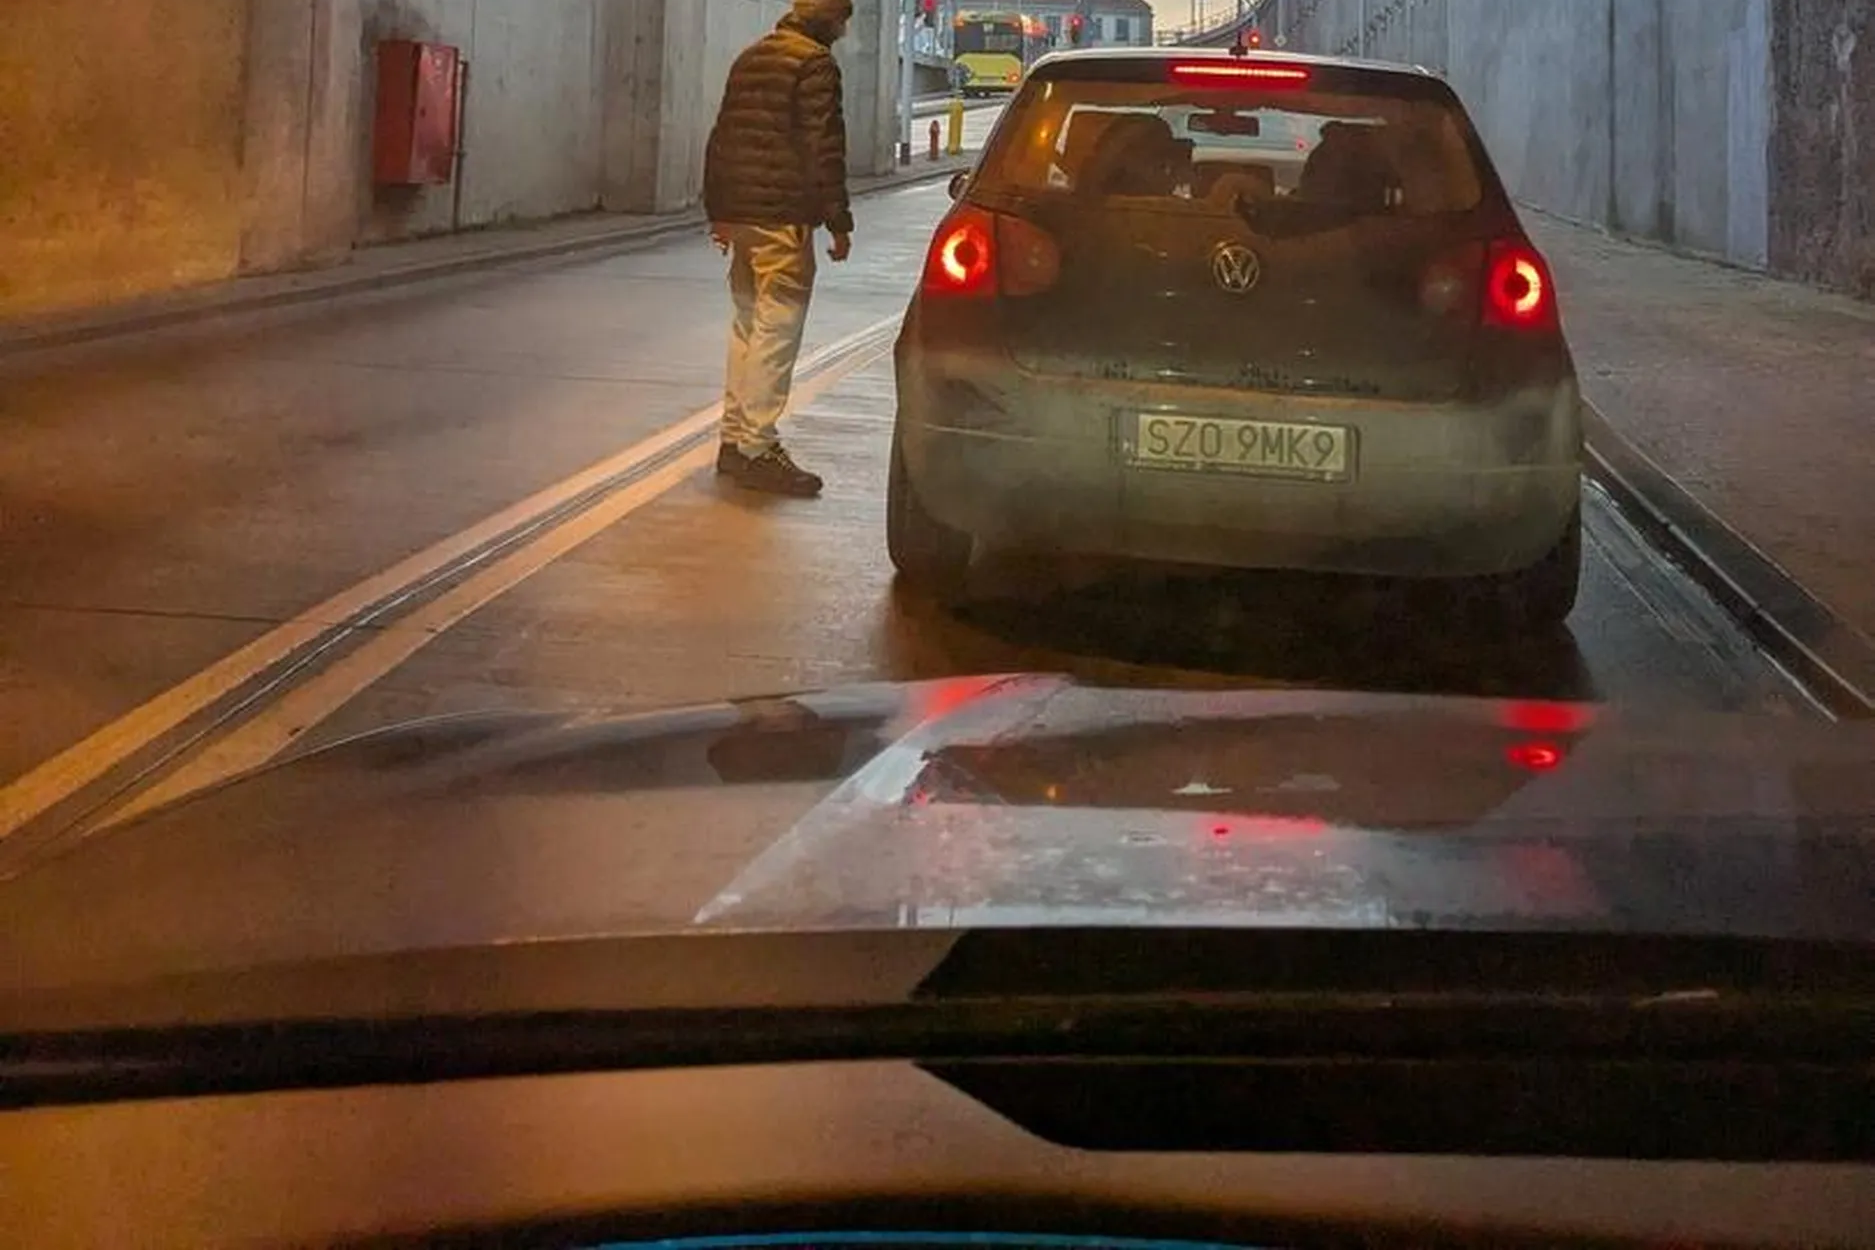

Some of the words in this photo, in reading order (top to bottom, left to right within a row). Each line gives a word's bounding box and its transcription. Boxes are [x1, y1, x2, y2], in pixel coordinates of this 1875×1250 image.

[1214, 246, 1259, 292] VW
[1146, 418, 1223, 458] SZO
[1237, 424, 1336, 468] 9MK9
